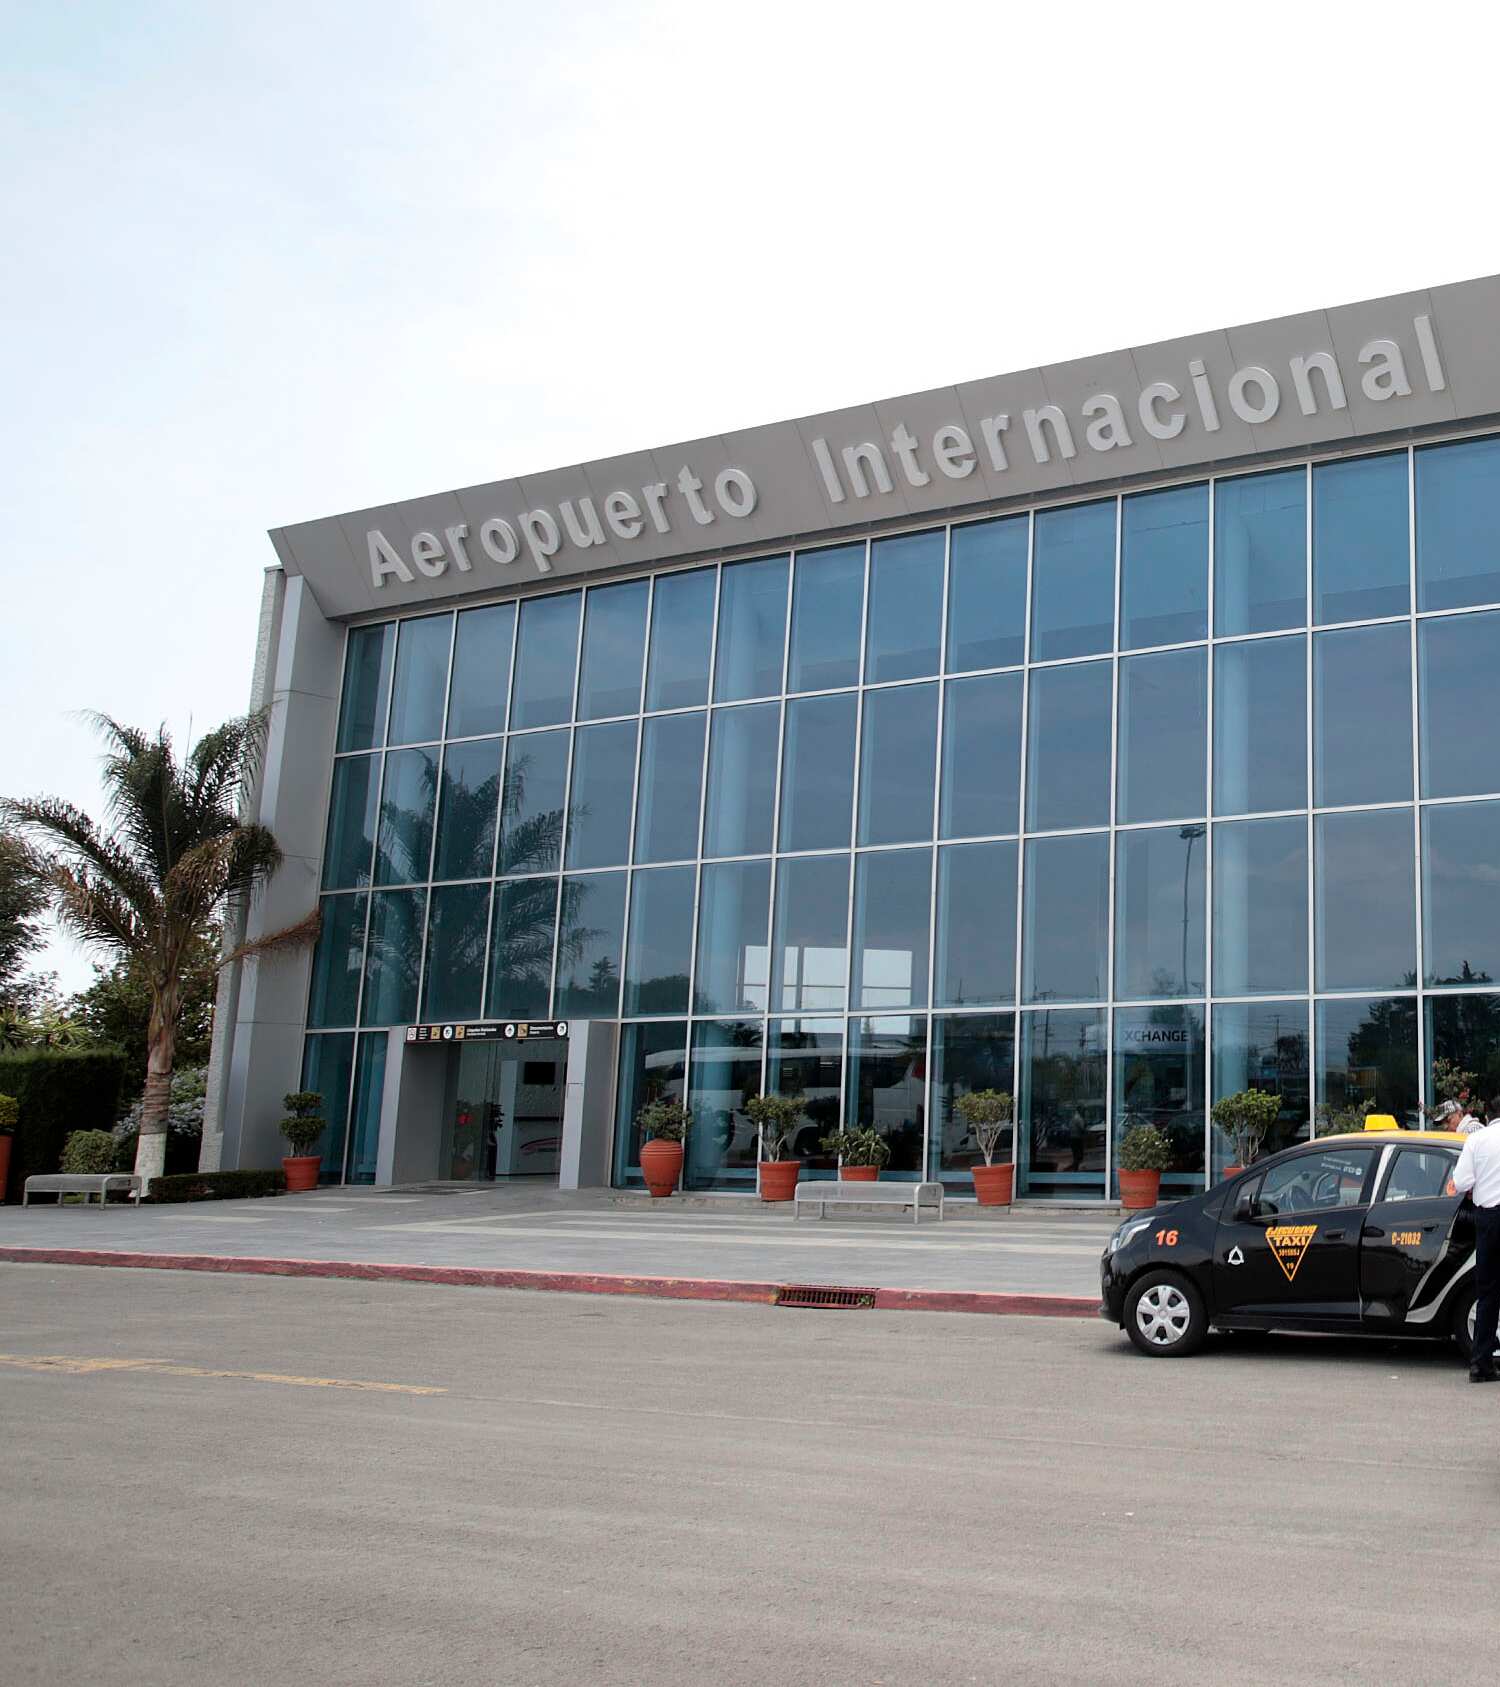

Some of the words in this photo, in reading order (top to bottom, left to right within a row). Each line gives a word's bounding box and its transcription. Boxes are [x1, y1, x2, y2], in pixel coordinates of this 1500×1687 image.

[366, 464, 758, 588] Aeropuerto
[812, 313, 1446, 503] Internacional
[1156, 1230, 1178, 1246] 16
[1274, 1236, 1306, 1246] TAXI
